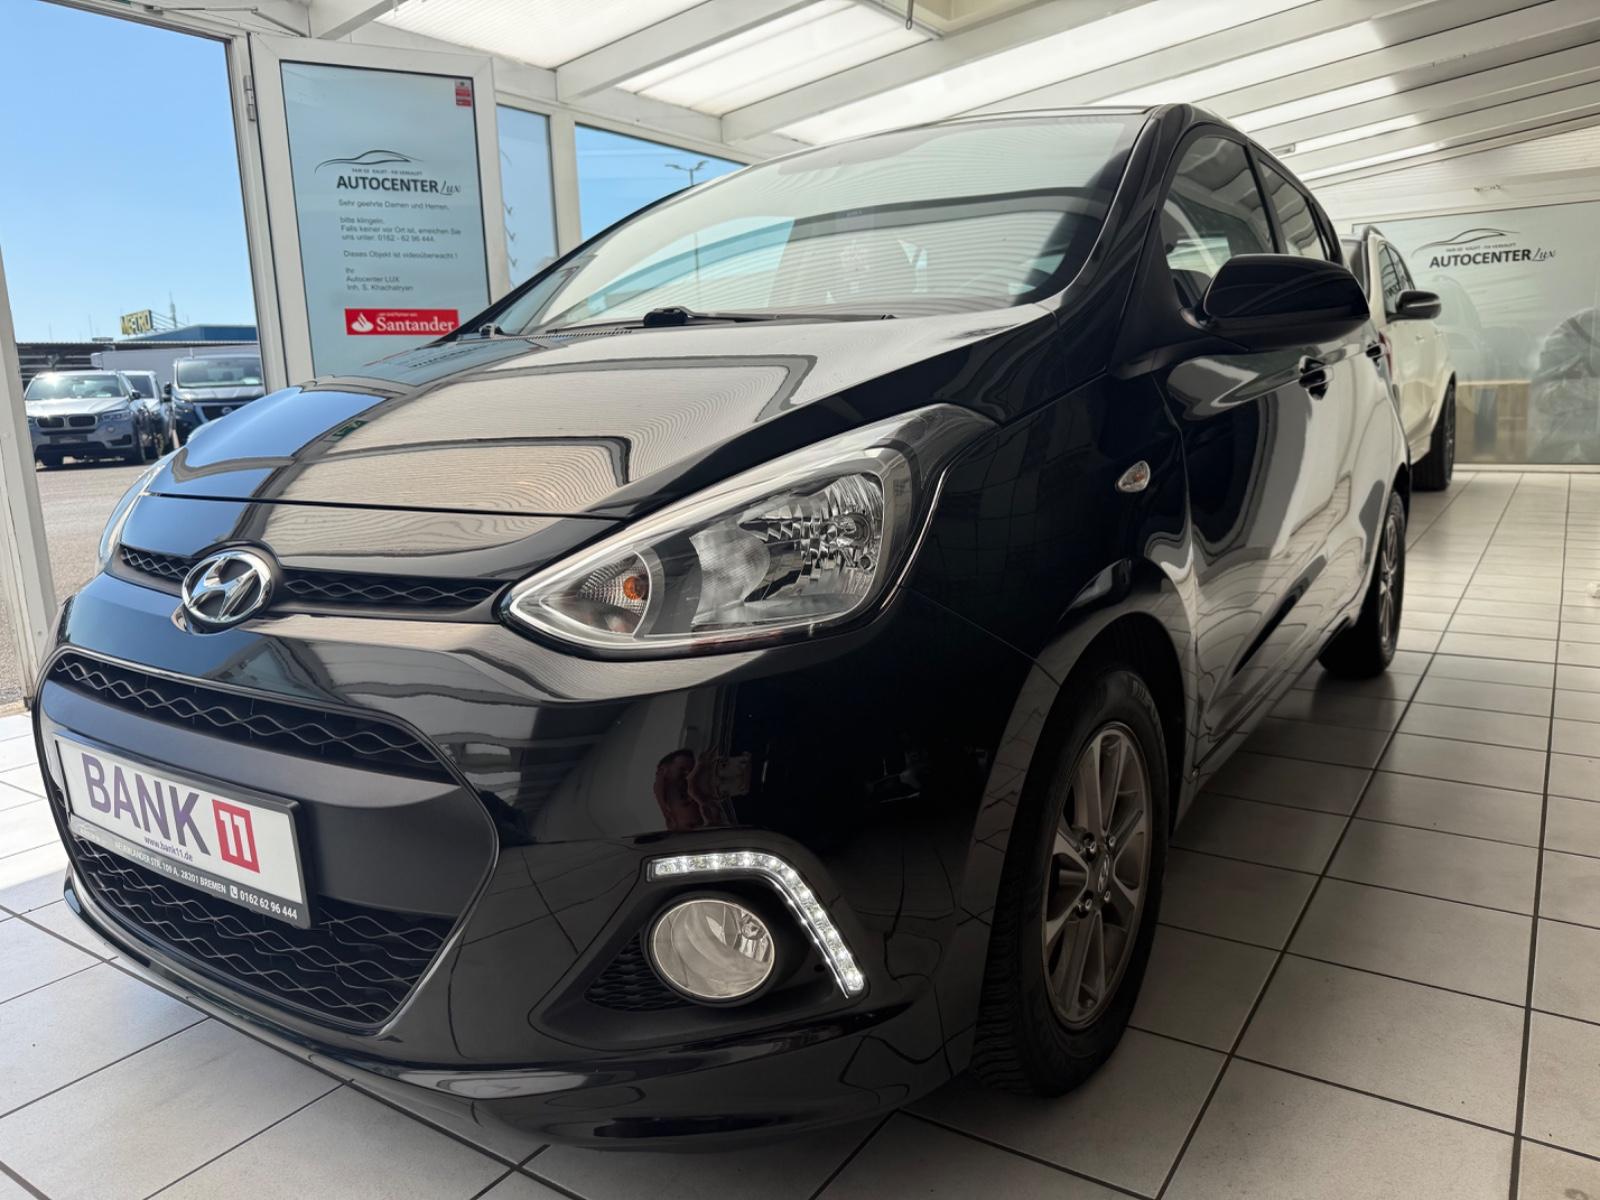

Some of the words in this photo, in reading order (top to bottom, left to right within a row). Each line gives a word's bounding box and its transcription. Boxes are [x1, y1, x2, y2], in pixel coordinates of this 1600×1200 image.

[336, 175, 439, 193] AUTOCENTER
[439, 180, 461, 196] Lux
[338, 198, 355, 207] Sehr
[357, 200, 383, 208] geehrte
[384, 200, 409, 208] Damen
[411, 201, 424, 209] und
[341, 224, 357, 232] Falls
[343, 249, 367, 258] Dieses
[369, 250, 392, 259] Objekt
[1429, 249, 1532, 269] AUTOCENTER
[1532, 248, 1556, 262] Lux
[346, 275, 384, 283] Autocenter
[121, 310, 152, 335] METRO
[376, 316, 455, 331] Santander
[81, 752, 212, 857] BANK
[144, 836, 194, 862] www.bank11.de
[200, 877, 227, 894] BREMEN
[240, 890, 259, 906] 0162
[259, 897, 270, 911] 62
[270, 901, 281, 914] 96
[282, 906, 298, 920] 444
